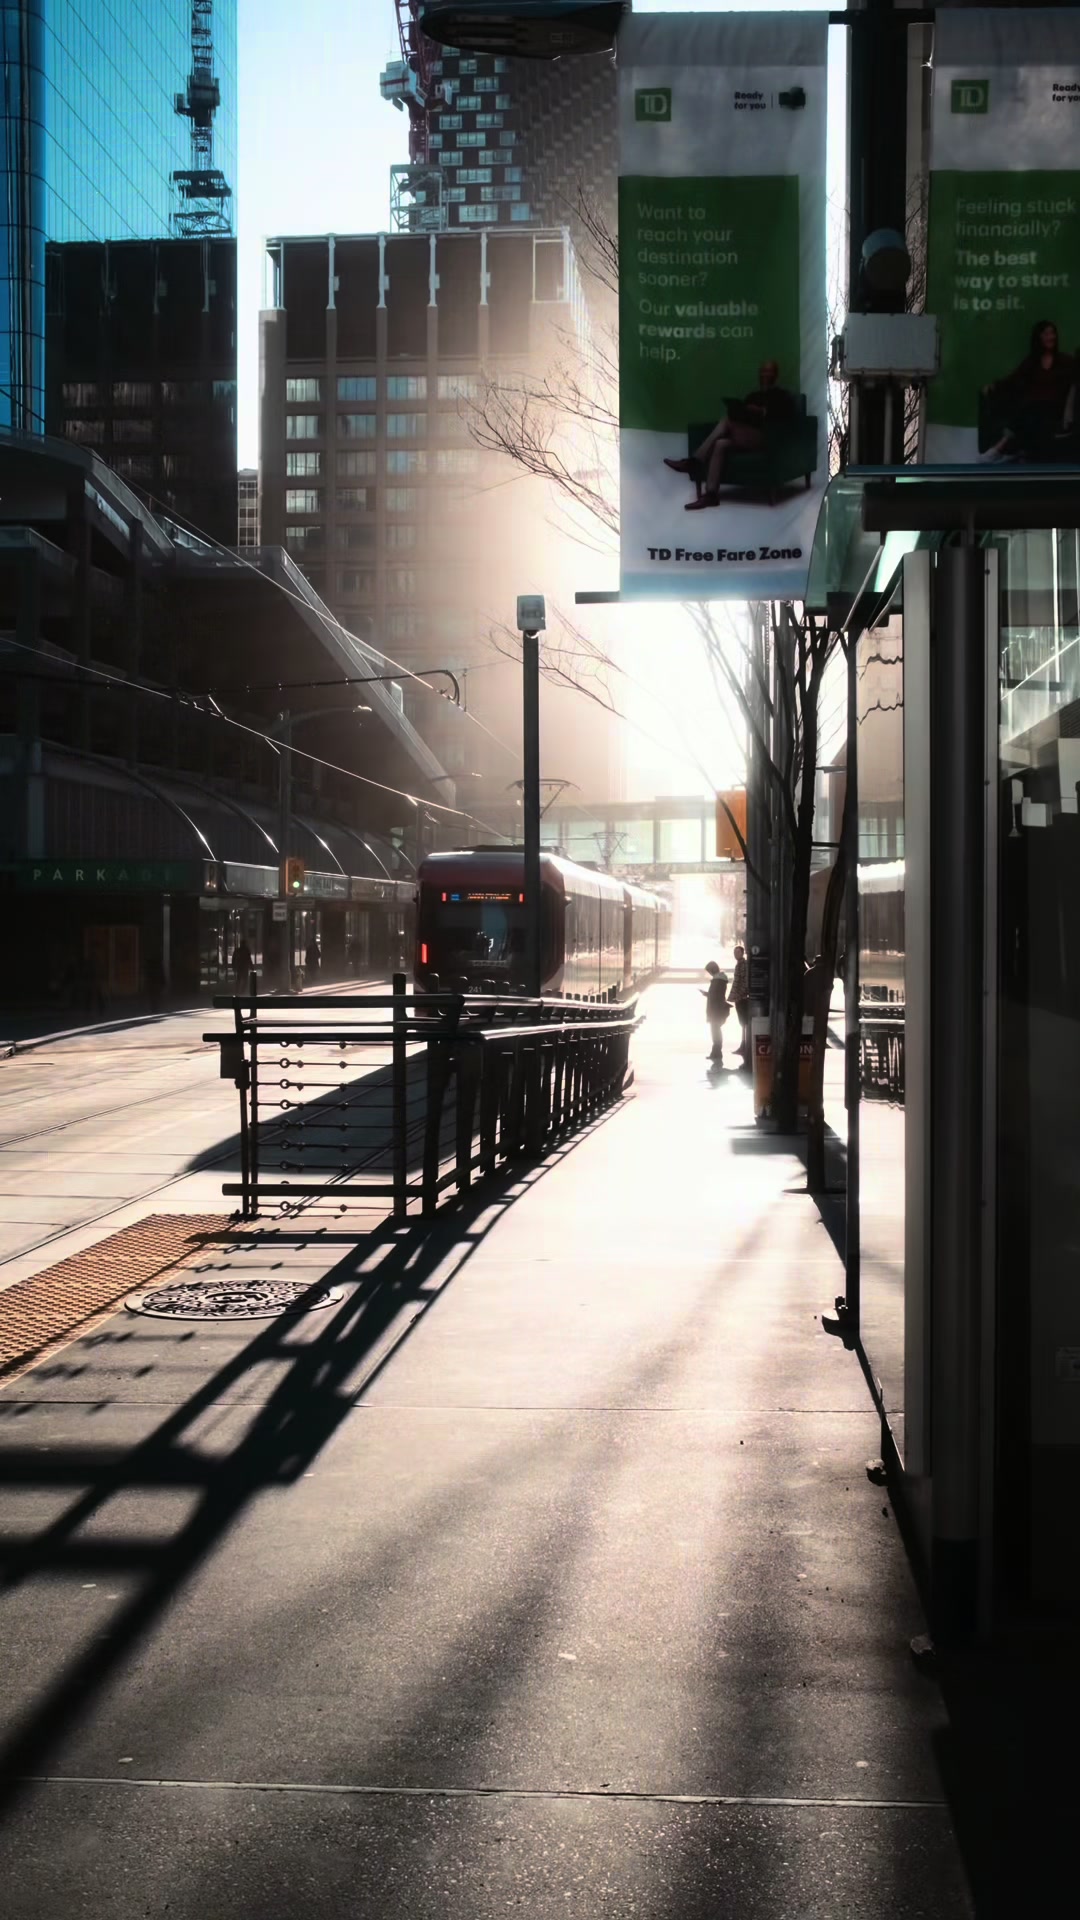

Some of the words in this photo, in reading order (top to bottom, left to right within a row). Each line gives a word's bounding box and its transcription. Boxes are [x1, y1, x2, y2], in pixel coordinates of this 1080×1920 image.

[639, 94, 668, 115] TD
[734, 91, 764, 102] Ready
[955, 85, 985, 107] TD
[1052, 93, 1066, 102] for
[1068, 94, 1080, 104] yo
[734, 101, 747, 110] for
[749, 103, 767, 111] you
[637, 202, 683, 220] Want
[688, 205, 706, 220] to
[956, 198, 1022, 217] Feeling
[1026, 197, 1077, 214] stuck
[637, 227, 688, 242] reach
[693, 229, 735, 245] your
[955, 219, 1061, 238] financially?
[637, 248, 739, 264] destination
[955, 250, 991, 266] The
[994, 250, 1038, 266] best
[638, 271, 708, 287] sooner?
[955, 274, 995, 291] way
[998, 273, 1018, 288] to
[1021, 272, 1071, 288] start
[638, 299, 671, 316] Our
[674, 299, 759, 317] valuable
[953, 292, 969, 310] is
[972, 296, 993, 311] to
[995, 294, 1025, 310] sit.
[638, 323, 717, 339] rewards
[720, 325, 754, 338] can
[639, 341, 681, 363] help.
[647, 547, 672, 561] TD
[675, 547, 714, 562] Free
[717, 548, 757, 562] Fare
[759, 546, 803, 561] Zone
[468, 985, 483, 994] 241
